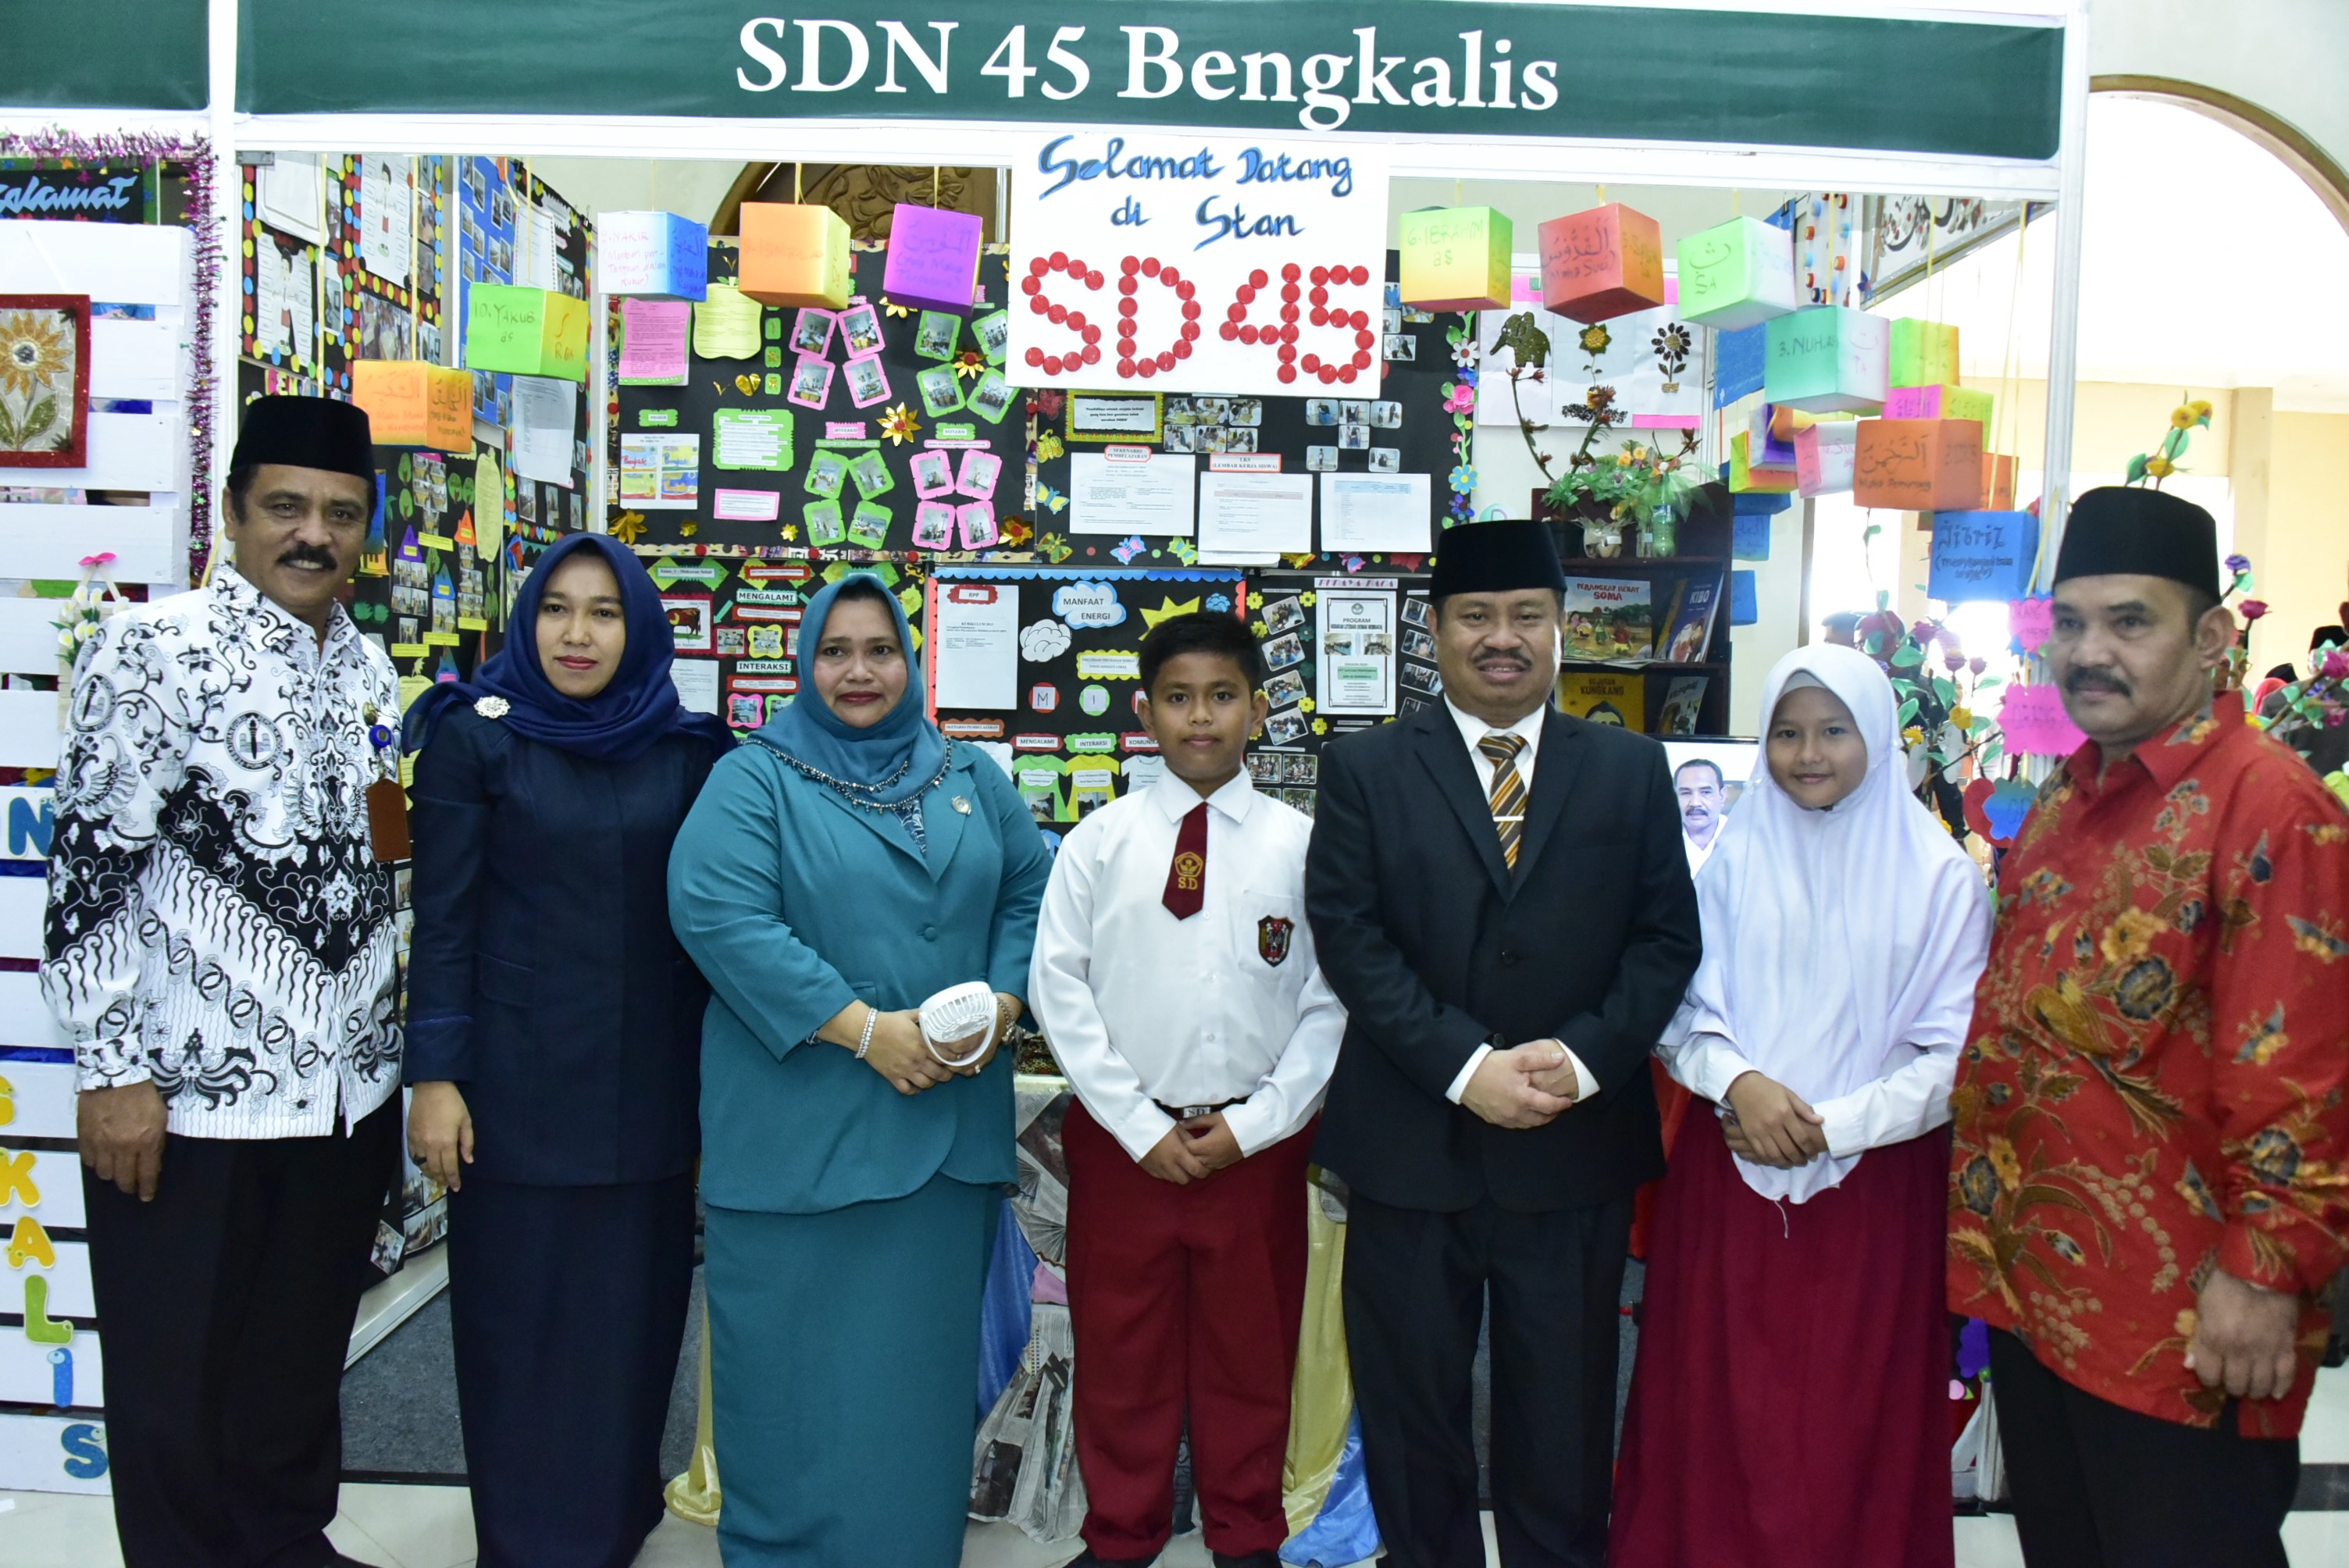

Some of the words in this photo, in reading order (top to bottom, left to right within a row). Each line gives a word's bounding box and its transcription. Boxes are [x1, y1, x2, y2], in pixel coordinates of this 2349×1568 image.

[736, 17, 959, 94] SDN
[980, 24, 1091, 100] 45
[1117, 25, 1559, 132] Bengkalis
[1038, 135, 1230, 201] Selamat
[1234, 147, 1353, 196] Datang
[1110, 196, 1150, 226] di
[1192, 195, 1306, 251] Stan
[1577, 583, 1616, 592] PERANGKAP
[1617, 586, 1640, 594] HEBAT
[738, 592, 794, 602] MENGALAMI
[1593, 591, 1624, 601] SOMA
[1688, 590, 1711, 604] KIBO
[739, 662, 789, 671] INTERAKSI
[1580, 686, 1625, 696] KUNGKANG
[1037, 692, 1049, 707] M
[1178, 876, 1199, 891] SD
